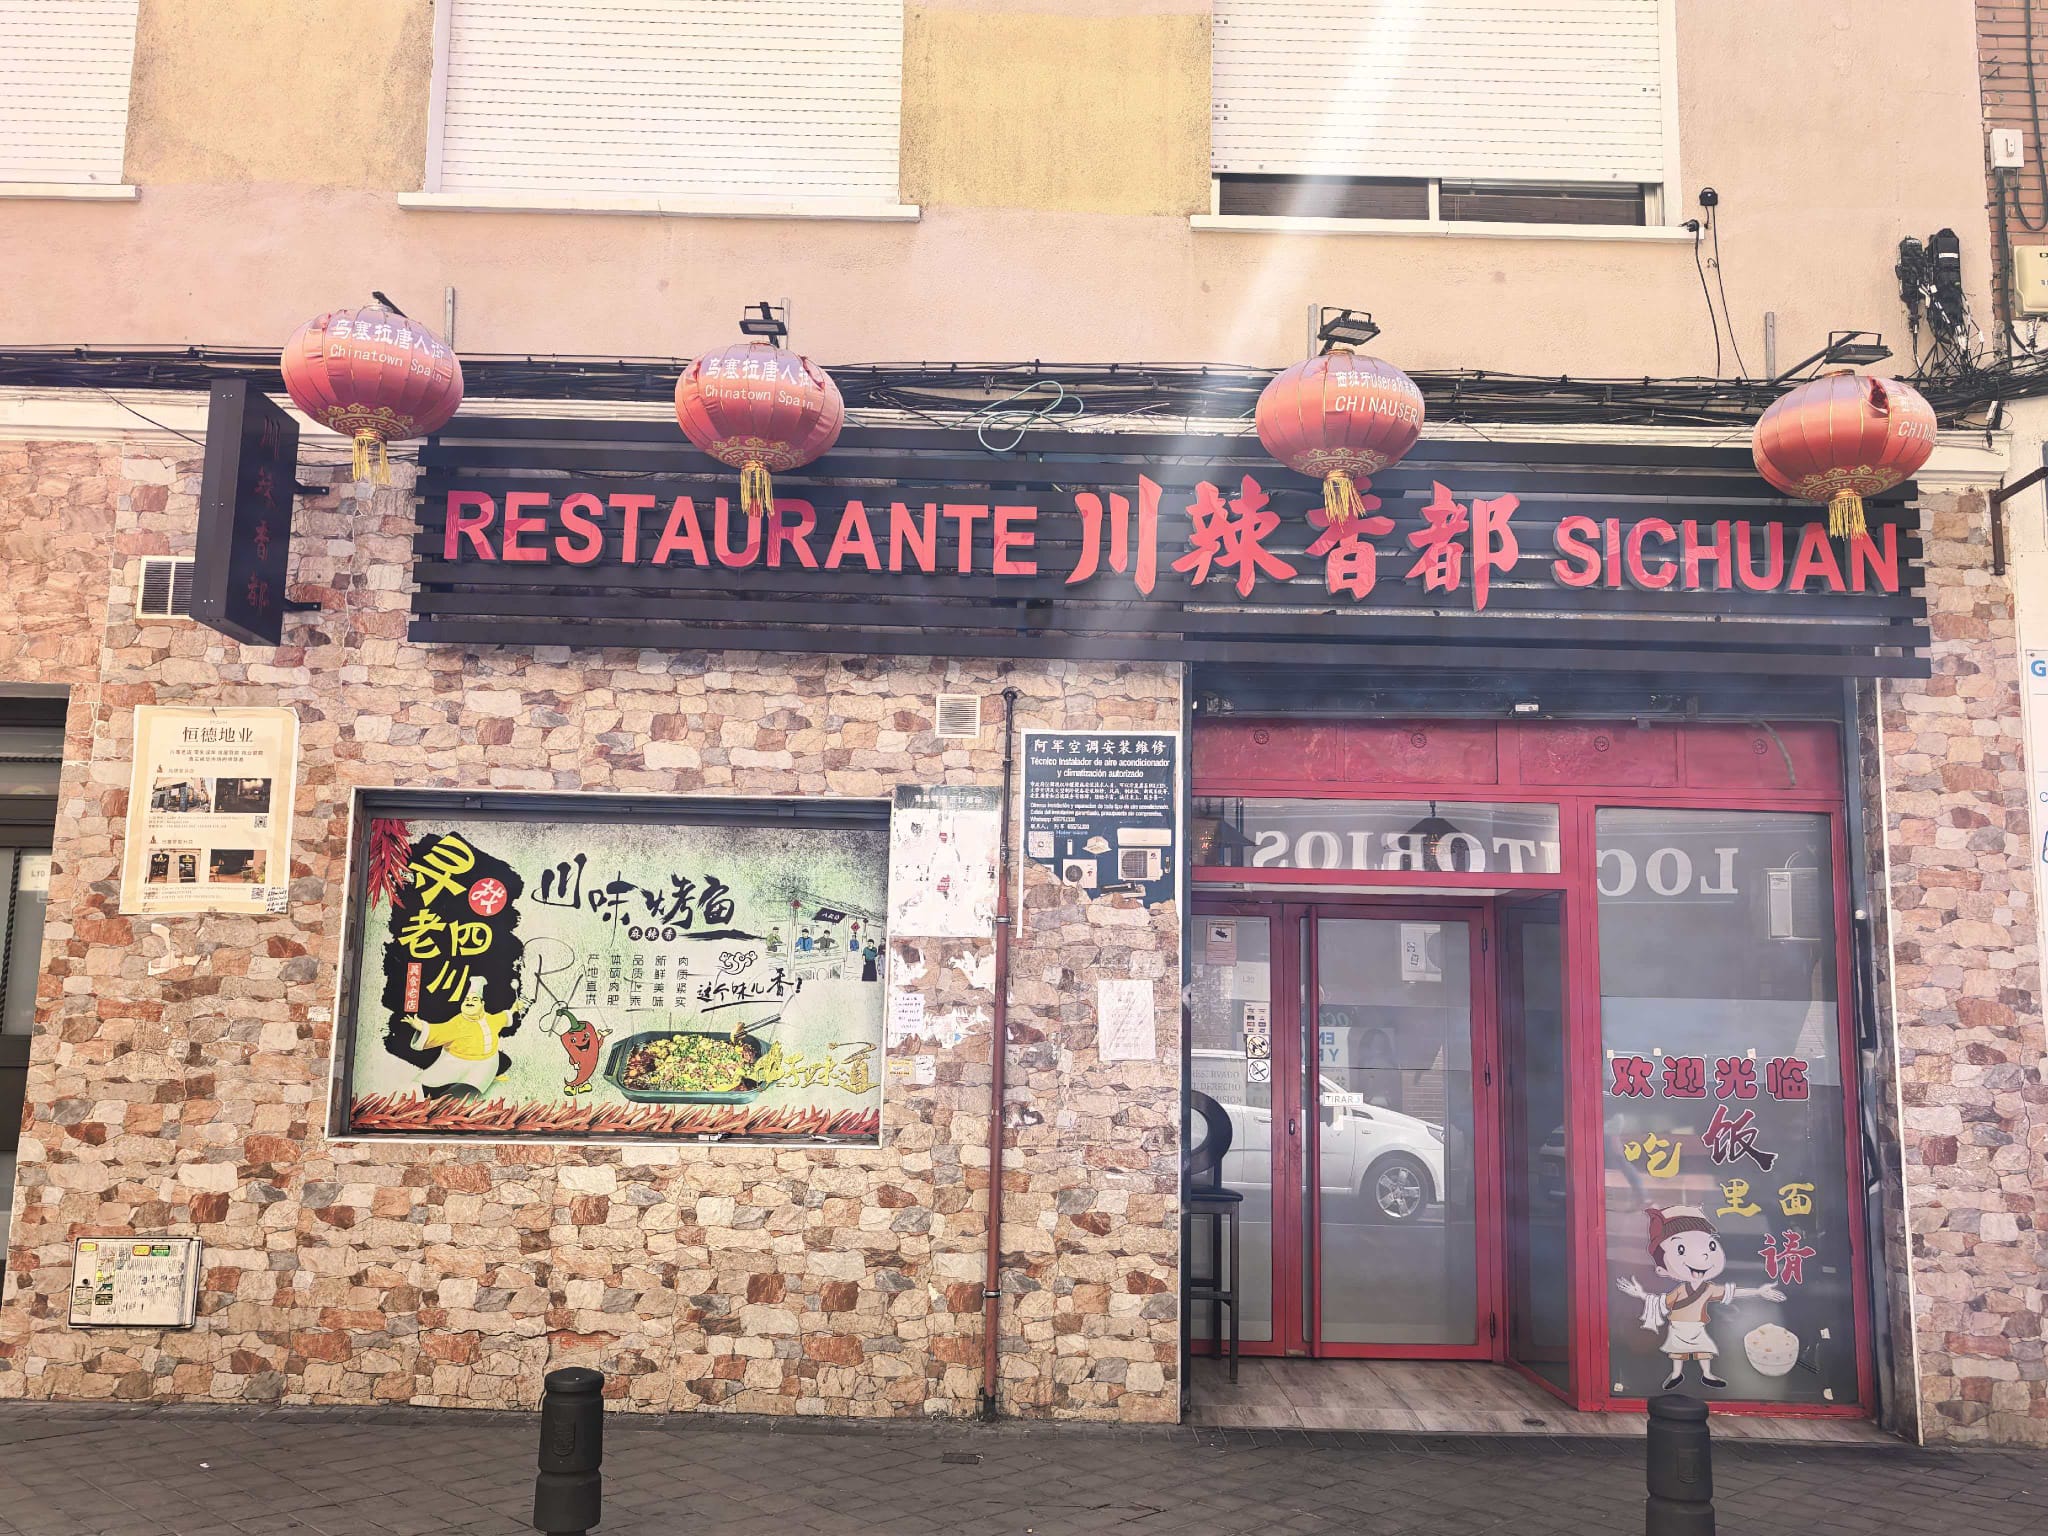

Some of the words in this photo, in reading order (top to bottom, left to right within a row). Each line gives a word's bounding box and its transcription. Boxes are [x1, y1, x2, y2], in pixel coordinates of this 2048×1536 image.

[330, 344, 403, 367] Chinatown
[411, 358, 442, 383] Spain
[705, 384, 771, 401] Chinatown
[778, 390, 814, 409] Spain
[443, 490, 1037, 576] RESTAURANTE
[1065, 473, 1521, 612] 川辣香都
[1552, 515, 1899, 593] SICHUAN
[182, 726, 254, 743] 恒德地业
[1057, 770, 1061, 778] y
[1094, 758, 1103, 766] de
[531, 853, 735, 943] 川味烤鱼
[652, 955, 667, 1007] 新鲜美味
[1326, 1095, 1354, 1103] TIRAR
[1611, 1056, 1810, 1101] 欢迎光临
[1758, 1229, 1816, 1285] 请
